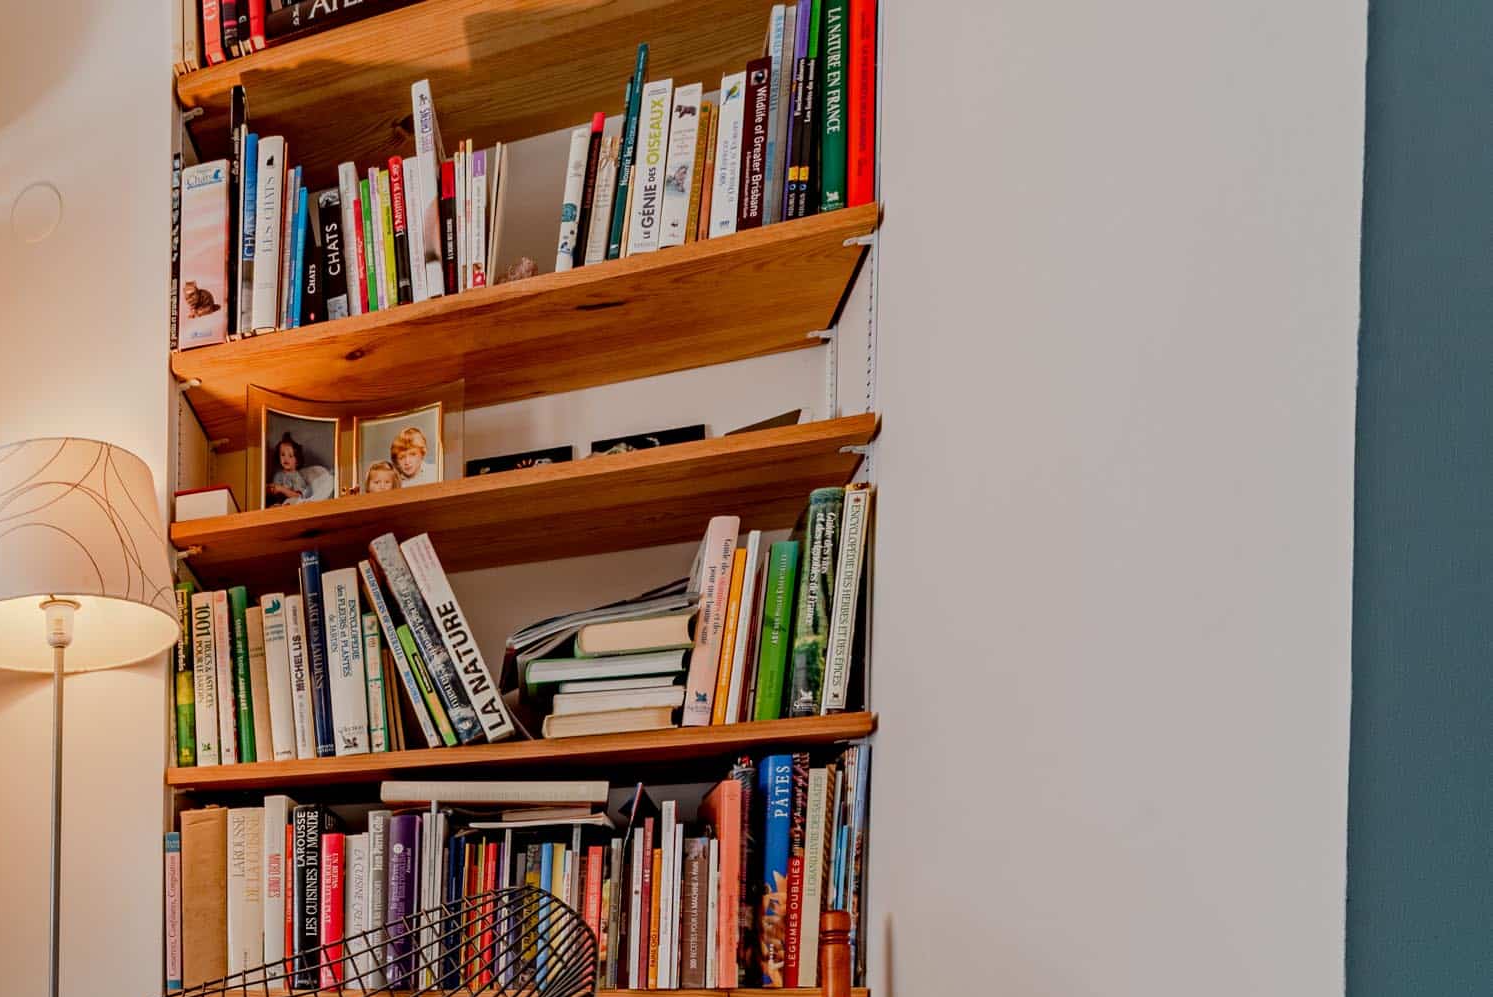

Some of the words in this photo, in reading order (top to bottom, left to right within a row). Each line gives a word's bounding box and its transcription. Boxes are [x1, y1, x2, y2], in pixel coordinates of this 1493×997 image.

[827, 6, 842, 24] LA
[827, 25, 842, 68] NATURE
[827, 72, 842, 87] EN
[754, 87, 767, 123] Wildlife
[826, 90, 840, 134] FRANCE
[645, 97, 665, 164] OISEAUX
[751, 136, 764, 172] Greater
[648, 166, 657, 182] DES
[638, 184, 657, 229] GÉNIE
[748, 174, 761, 217] Brisbane
[325, 222, 341, 277] CHATS
[642, 231, 651, 240] LE
[307, 264, 317, 295] CHATS
[826, 512, 837, 538] Guide
[845, 504, 862, 570] ENCYCLOPÉDIE
[823, 539, 835, 557] des
[843, 571, 855, 590] DES
[195, 604, 210, 639] 1001
[841, 590, 853, 625] HERBES
[292, 635, 302, 650] LIS
[341, 641, 352, 678] PLANTES
[434, 599, 491, 695] NATURE
[291, 651, 305, 692] MICHEL
[478, 699, 507, 734] LA
[771, 765, 791, 818] PÂTES
[233, 816, 245, 878] LAROUSSE
[297, 811, 306, 868] LAROUSSE
[306, 810, 319, 848] MONDE
[306, 850, 318, 866] DU
[306, 867, 318, 915] CUISINES
[306, 916, 319, 936] LES
